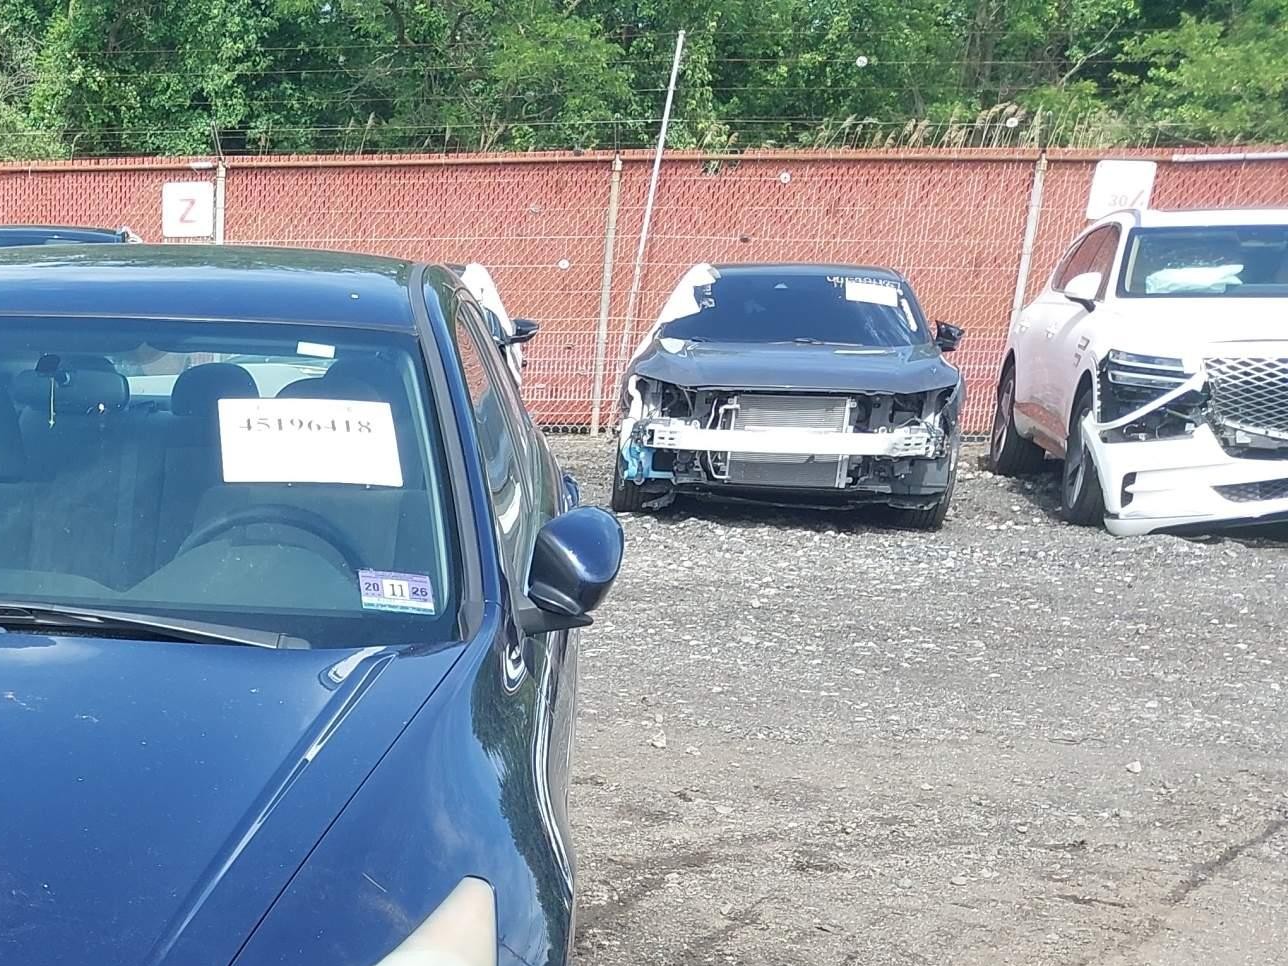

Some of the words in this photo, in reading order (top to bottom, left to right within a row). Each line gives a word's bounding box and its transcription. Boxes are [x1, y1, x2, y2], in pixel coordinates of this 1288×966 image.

[179, 198, 198, 223] Z
[239, 417, 373, 434] 45196418
[364, 581, 380, 592] 20
[389, 583, 406, 597] 11
[411, 586, 428, 597] 26
